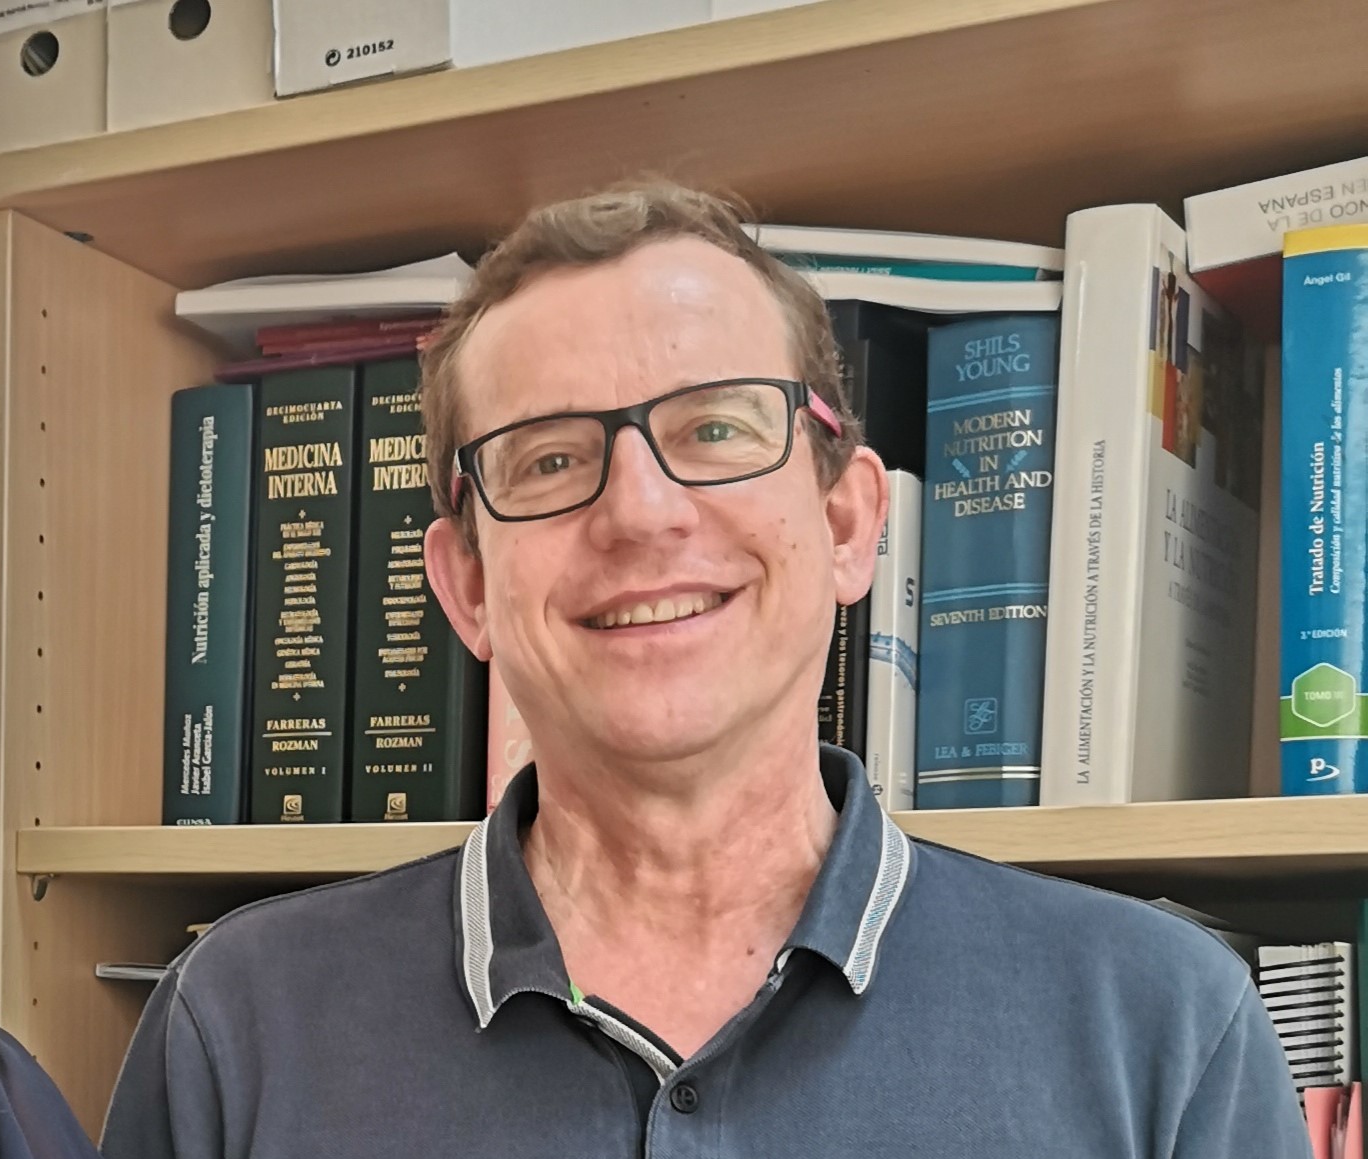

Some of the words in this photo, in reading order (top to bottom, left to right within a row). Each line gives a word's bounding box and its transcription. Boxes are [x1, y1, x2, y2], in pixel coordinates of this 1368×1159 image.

[346, 39, 394, 60] 210152
[1258, 185, 1334, 214] ESPAÑA
[1335, 272, 1351, 283] Gil
[964, 334, 1021, 360] SHILS
[956, 354, 1030, 381] YOUNG
[266, 401, 343, 416] DECIMOCUARTA
[283, 412, 324, 424] EDICIÓN
[953, 410, 1032, 435] MODERN
[944, 429, 1043, 457] NUTRITION
[196, 416, 218, 507] dietoterapia
[264, 442, 343, 472] MEDICINA
[979, 455, 999, 472] IN
[1090, 440, 1105, 494] HISTORIA
[268, 470, 338, 499] INTERNA
[935, 476, 1000, 500] HEALTH
[1004, 471, 1052, 489] AND
[1309, 441, 1325, 512] Nutrición
[955, 493, 1026, 517] DISEASE
[1090, 496, 1102, 510] LA
[198, 511, 214, 521] y
[1089, 511, 1101, 528] DE
[1309, 516, 1325, 534] de
[192, 524, 213, 588] aplicada
[1085, 532, 1100, 573] TRAVÉS
[1086, 573, 1098, 582] A
[1308, 538, 1325, 596] Tratado
[930, 608, 984, 626] SEVENTH
[988, 605, 1047, 621] EDITION
[1081, 587, 1098, 650] NUTRICIÓN
[190, 591, 209, 665] Nutrición
[1081, 652, 1095, 667] LA
[1081, 668, 1094, 676] Y
[182, 714, 192, 747] Muñoz
[266, 718, 327, 730] FARRERAS
[370, 715, 430, 728] FARRERAS
[1078, 679, 1094, 765] ALIMENTACIÓN
[192, 723, 202, 765] Aranceta
[272, 740, 318, 752] ROZMAN
[375, 736, 423, 749] ROZMAN
[935, 746, 957, 759] LEA
[961, 747, 971, 757] &
[181, 749, 191, 794] Mercedes
[191, 766, 201, 794] Javier
[201, 766, 211, 794] Isabel
[264, 766, 316, 776] VOLUMEN
[321, 766, 326, 775] I
[365, 763, 417, 774] VOLUMEN
[423, 763, 433, 772] II
[1077, 770, 1090, 785] LA
